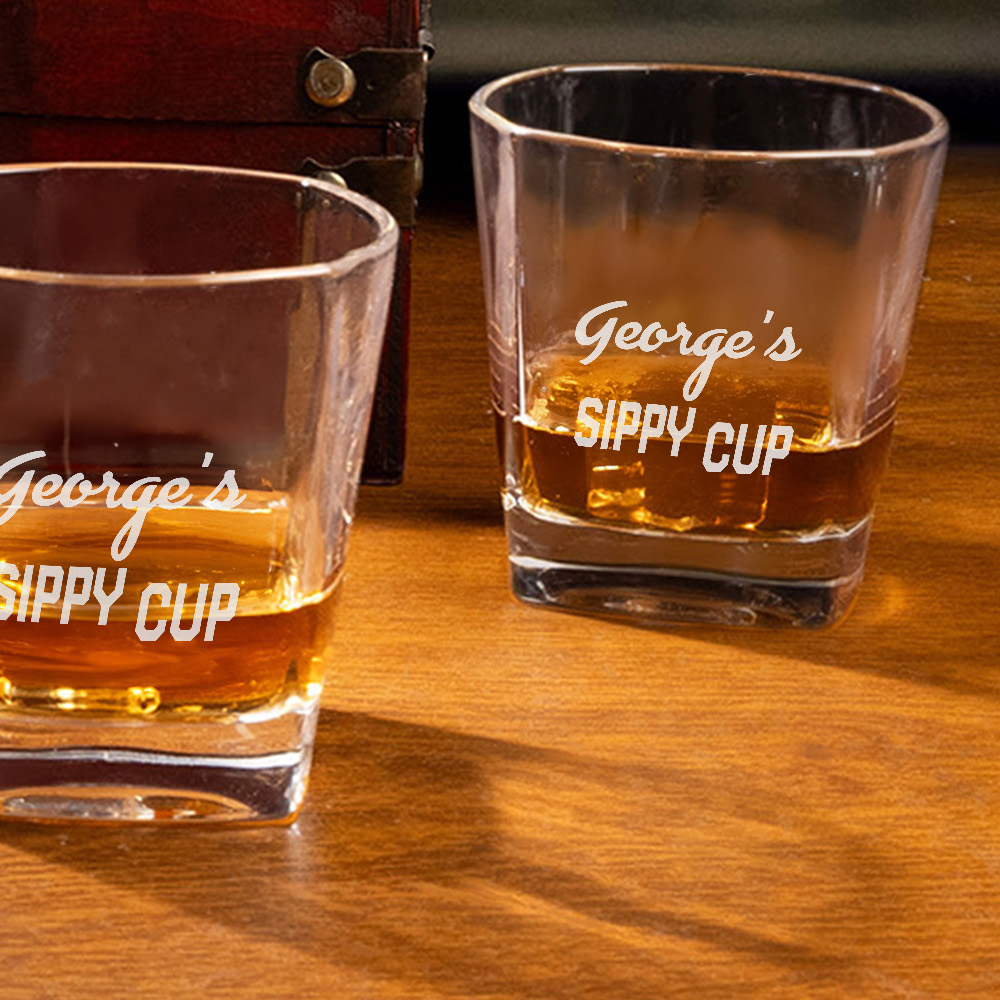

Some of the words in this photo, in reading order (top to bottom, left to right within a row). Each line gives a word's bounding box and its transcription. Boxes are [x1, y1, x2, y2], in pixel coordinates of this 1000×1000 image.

[575, 301, 801, 402] George's
[575, 397, 697, 456] SIPPY
[703, 422, 794, 475] CUP
[135, 583, 240, 641] CUP
